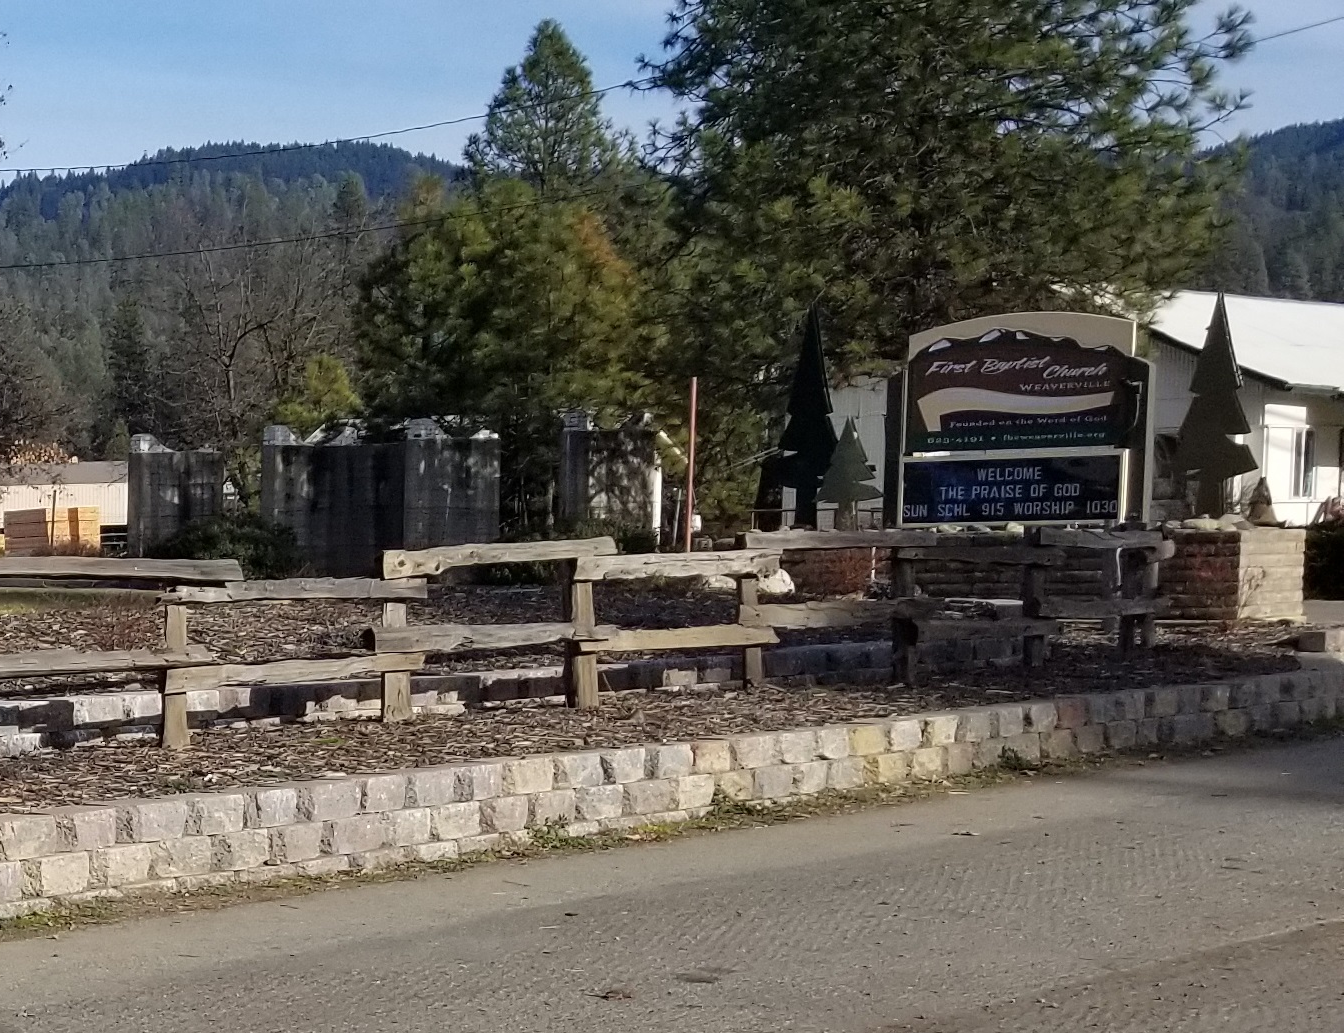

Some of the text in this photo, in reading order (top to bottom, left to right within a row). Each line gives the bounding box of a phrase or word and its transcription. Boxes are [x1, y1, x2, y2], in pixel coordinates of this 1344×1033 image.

[925, 356, 1108, 379] First Baptist Church
[1019, 380, 1110, 391] WEAVERVILLE
[949, 419, 995, 428] Founded
[1037, 416, 1066, 424] Word
[1070, 415, 1081, 423] of
[977, 467, 1042, 481] WELCOME
[939, 483, 1080, 500] THE PRAISE OF GOD
[903, 500, 1118, 518] SUN SCHL 915 WORSHIP 1030
